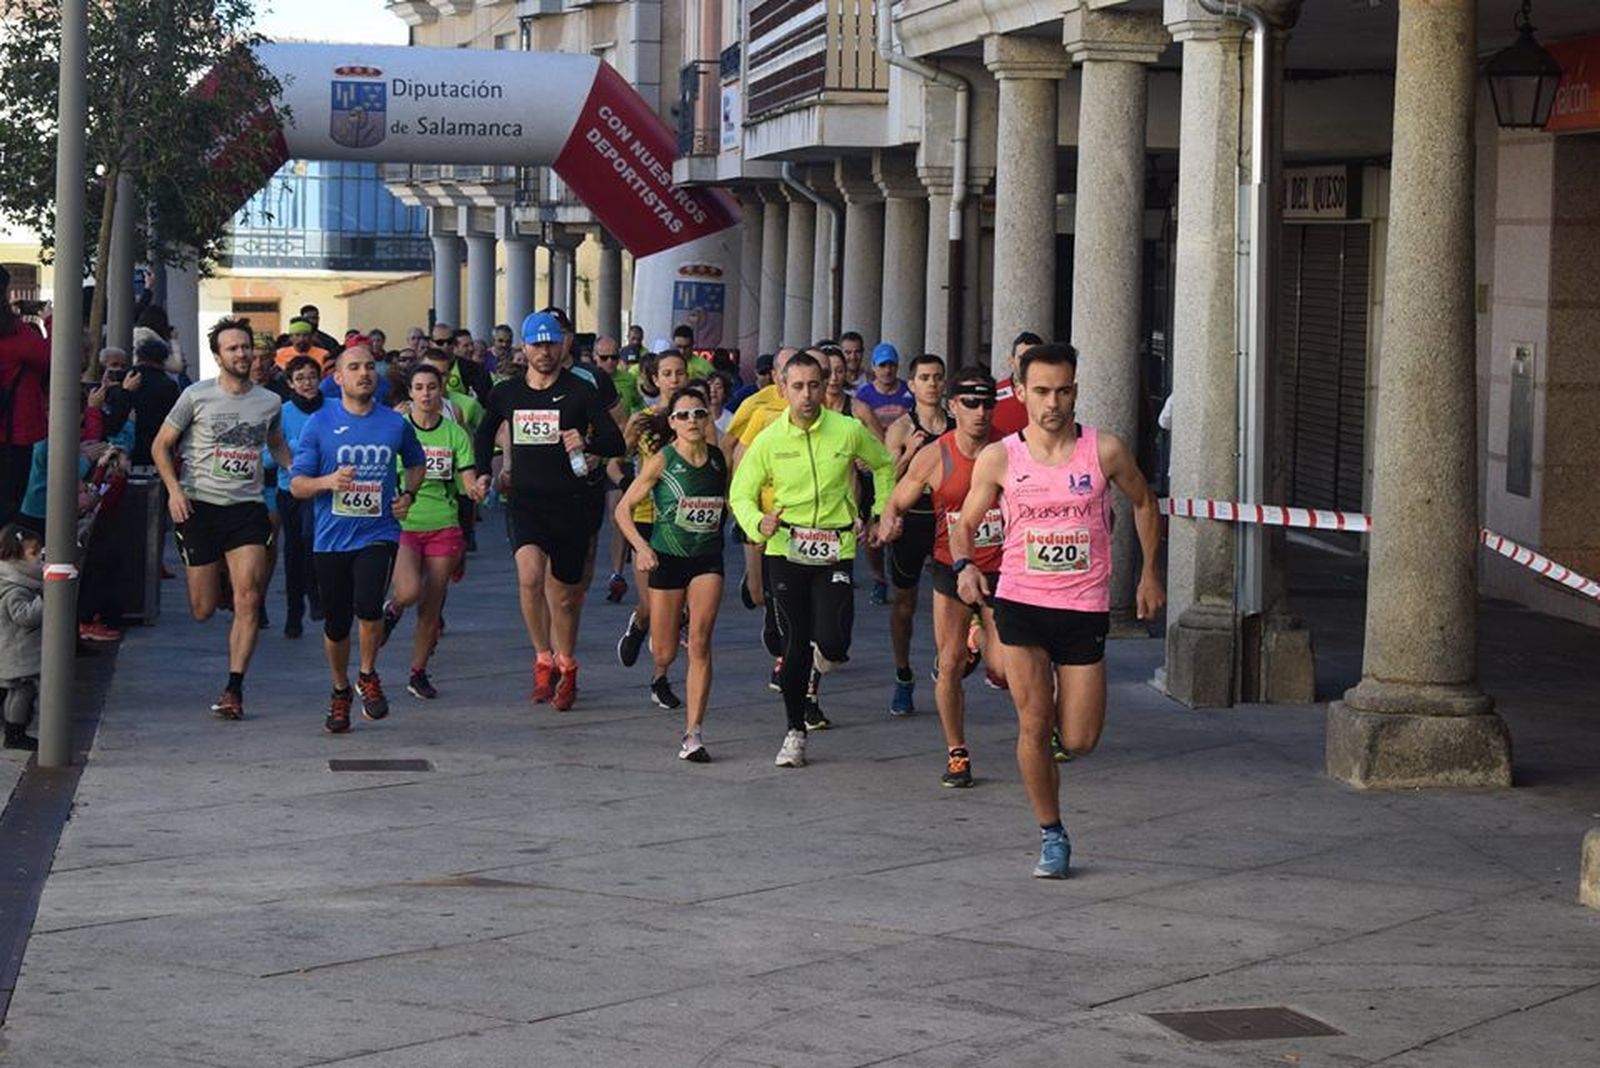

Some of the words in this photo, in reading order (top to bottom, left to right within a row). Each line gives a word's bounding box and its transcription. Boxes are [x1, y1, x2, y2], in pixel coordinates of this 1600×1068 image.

[392, 79, 503, 101] Diputación
[390, 120, 409, 134] de
[416, 116, 523, 137] Salamanca
[598, 106, 633, 142] CON
[586, 128, 684, 233] DEPORTISTAS
[1291, 177, 1309, 210] DEL
[1313, 175, 1345, 214] QUESO
[522, 422, 551, 436] 453
[222, 459, 249, 473] 434
[426, 457, 445, 471] 25
[341, 492, 373, 507] 466
[685, 509, 715, 524] 482
[1026, 530, 1089, 545] bedunia
[798, 540, 830, 557] 463
[1037, 545, 1078, 563] 420
